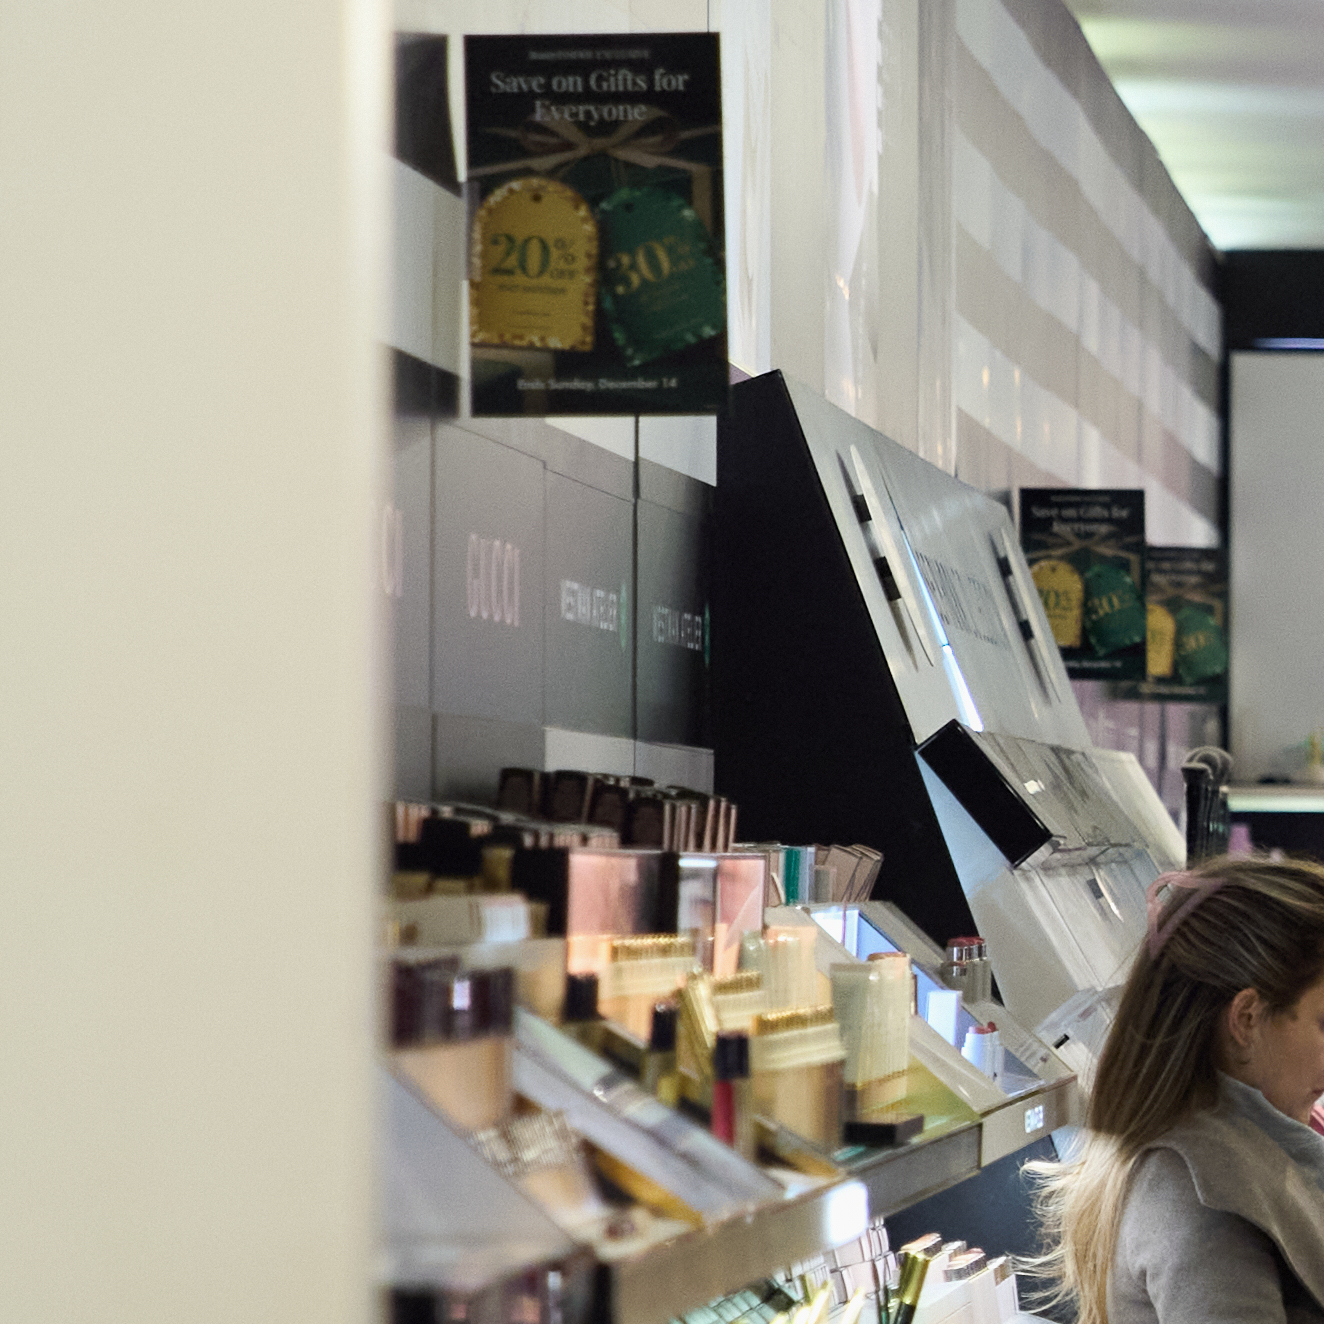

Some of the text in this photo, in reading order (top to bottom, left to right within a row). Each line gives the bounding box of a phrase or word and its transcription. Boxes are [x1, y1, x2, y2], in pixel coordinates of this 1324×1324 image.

[490, 67, 690, 93] Save on Gifts for
[534, 99, 648, 126] Everyone
